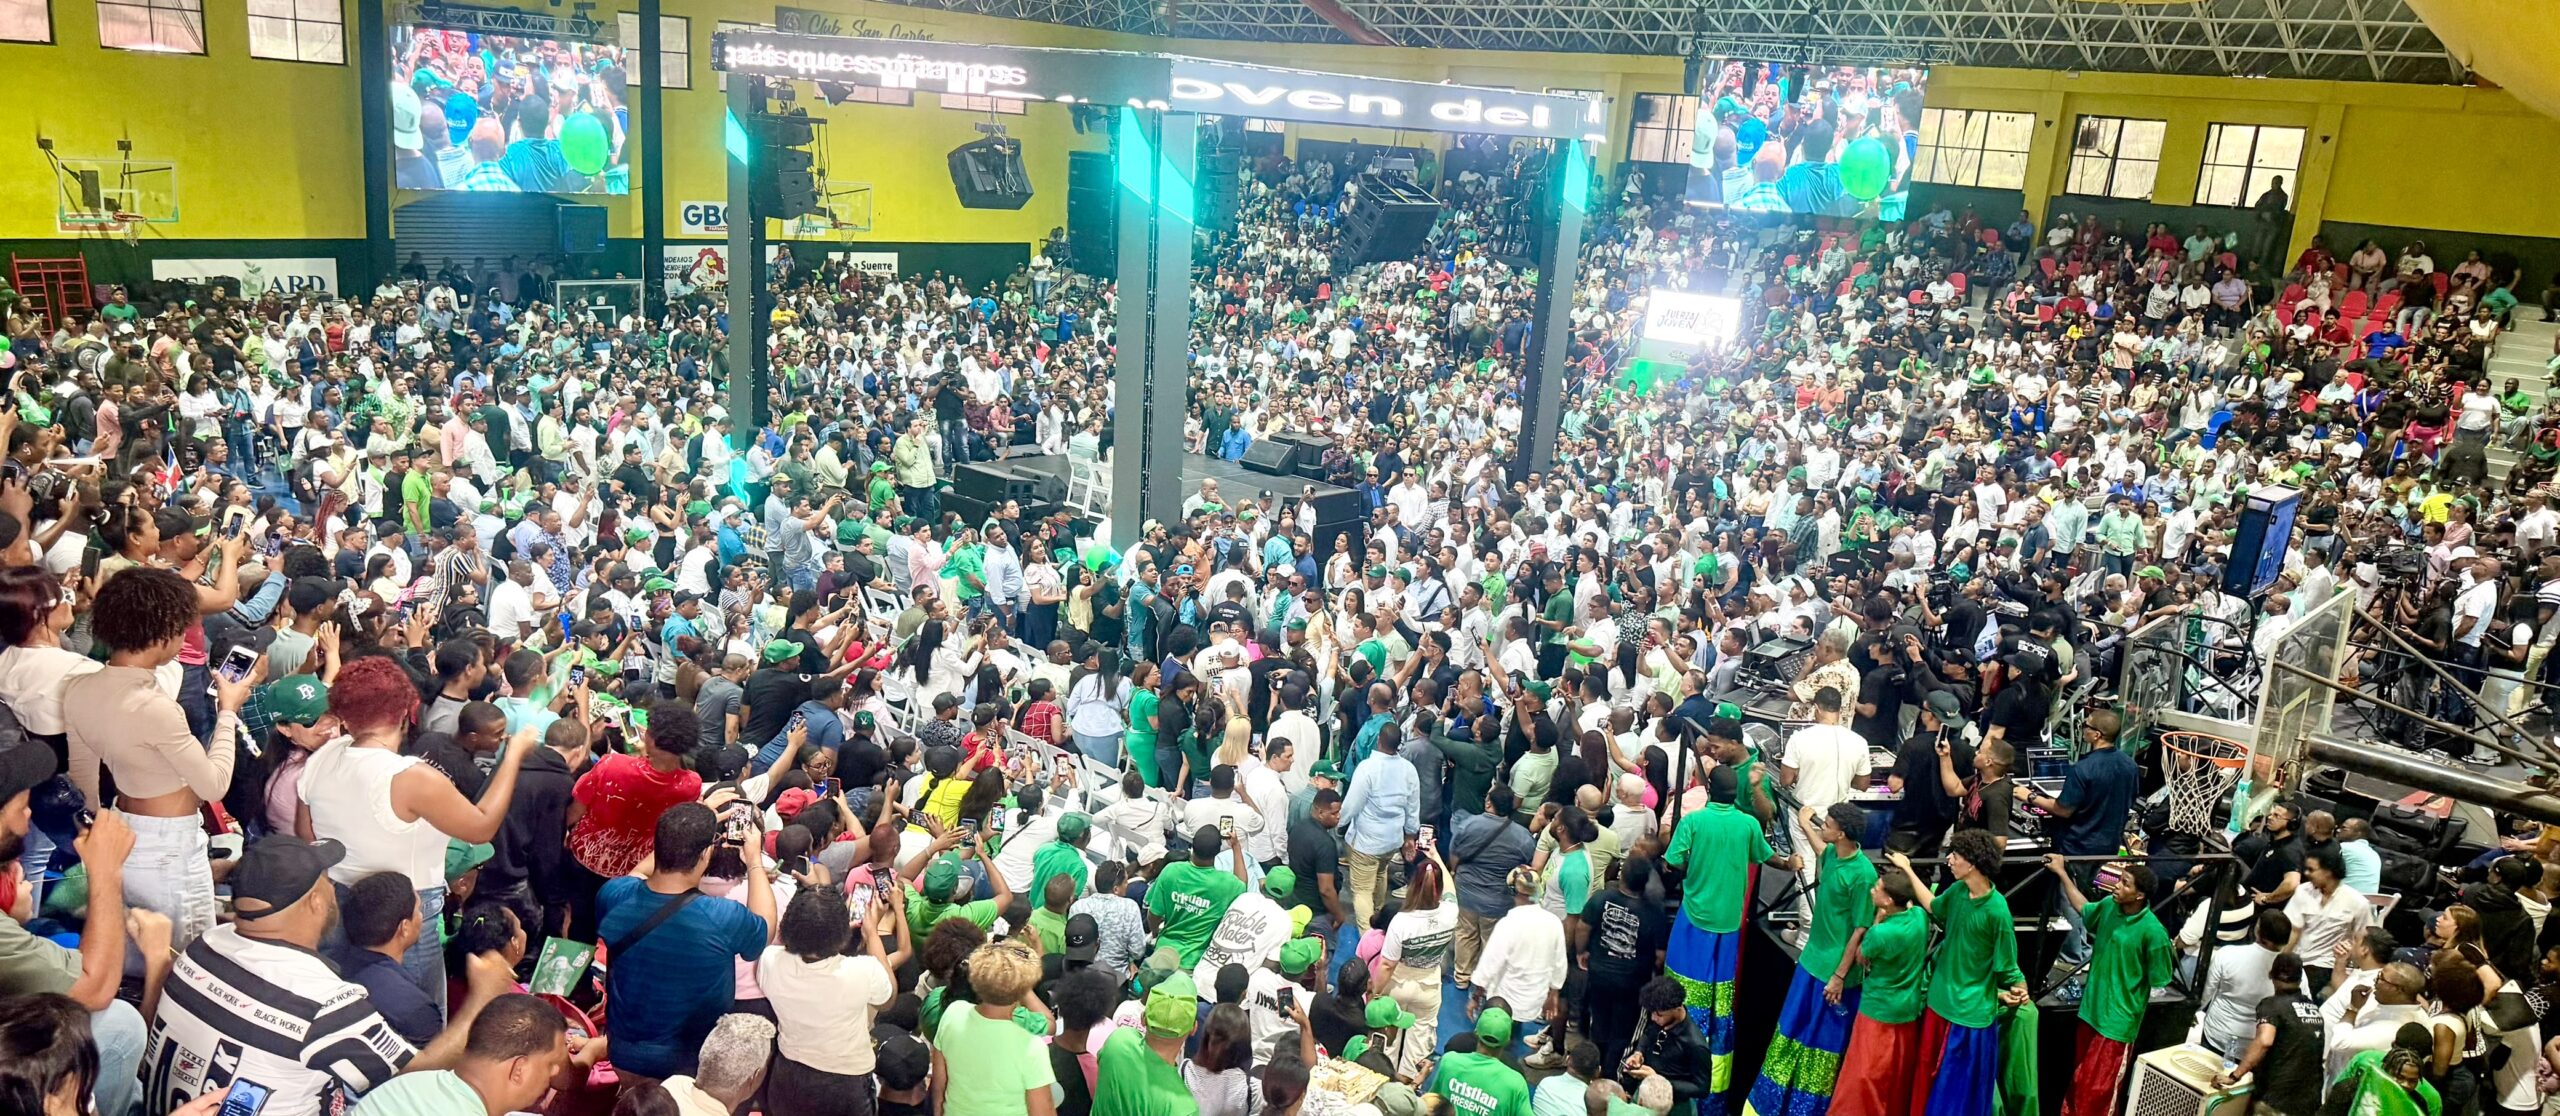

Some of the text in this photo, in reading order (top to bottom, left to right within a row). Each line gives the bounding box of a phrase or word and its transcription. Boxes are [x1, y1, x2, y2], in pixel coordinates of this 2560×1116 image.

[808, 13, 843, 35] Club
[850, 19, 883, 38] San
[1430, 98, 1550, 128] del
[1656, 313, 1699, 330] JOVEN
[1665, 308, 1696, 321] FUERZA
[1170, 890, 1211, 909] Cristian
[1214, 923, 1256, 945] Maker
[206, 982, 240, 1007] BLACK WORK
[253, 1008, 304, 1036] BLACK WORK
[1448, 1077, 1498, 1111] Cristian
[1449, 1093, 1491, 1116] PRESENTE
